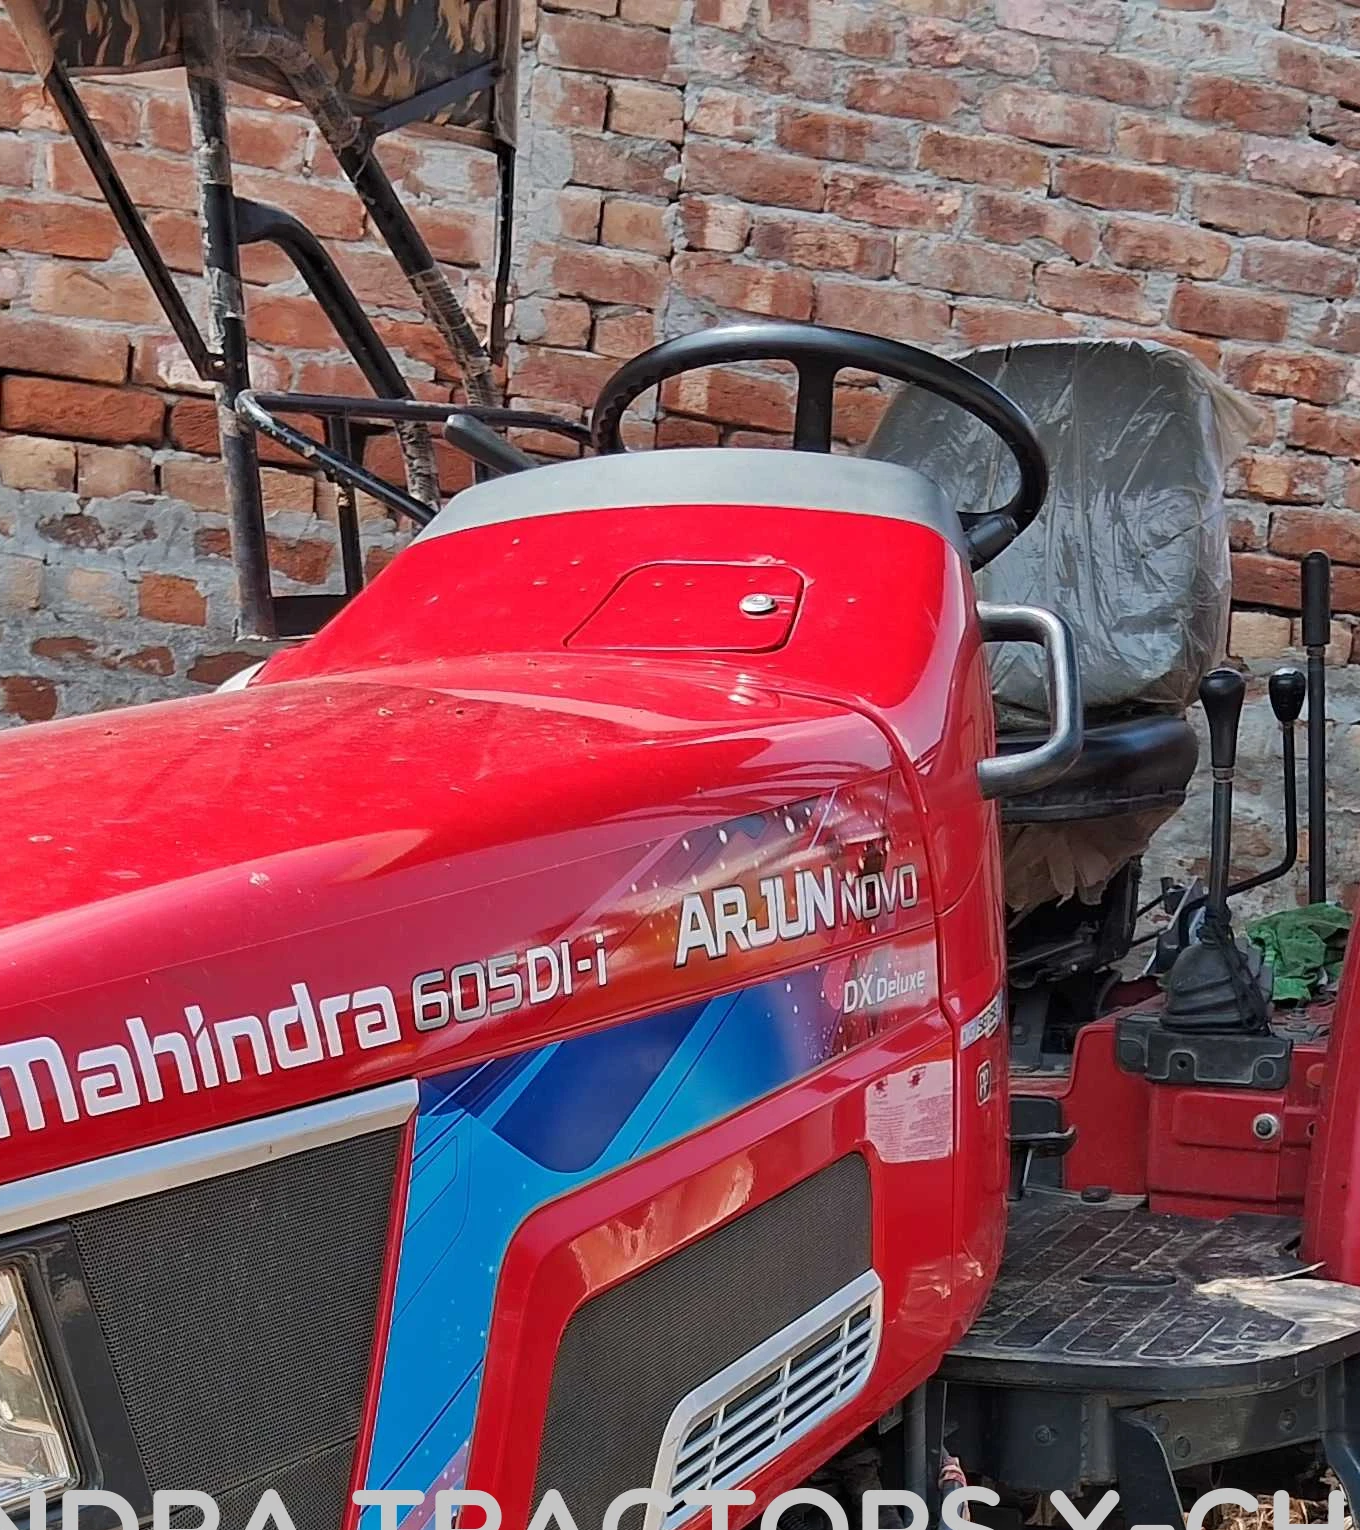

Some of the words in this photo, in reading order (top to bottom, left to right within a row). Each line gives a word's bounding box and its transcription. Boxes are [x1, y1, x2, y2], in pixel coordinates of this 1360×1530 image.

[674, 865, 836, 967] ARJUN
[841, 864, 917, 923] NOVO
[842, 973, 874, 1014] DX
[875, 966, 927, 1003] Deluxe
